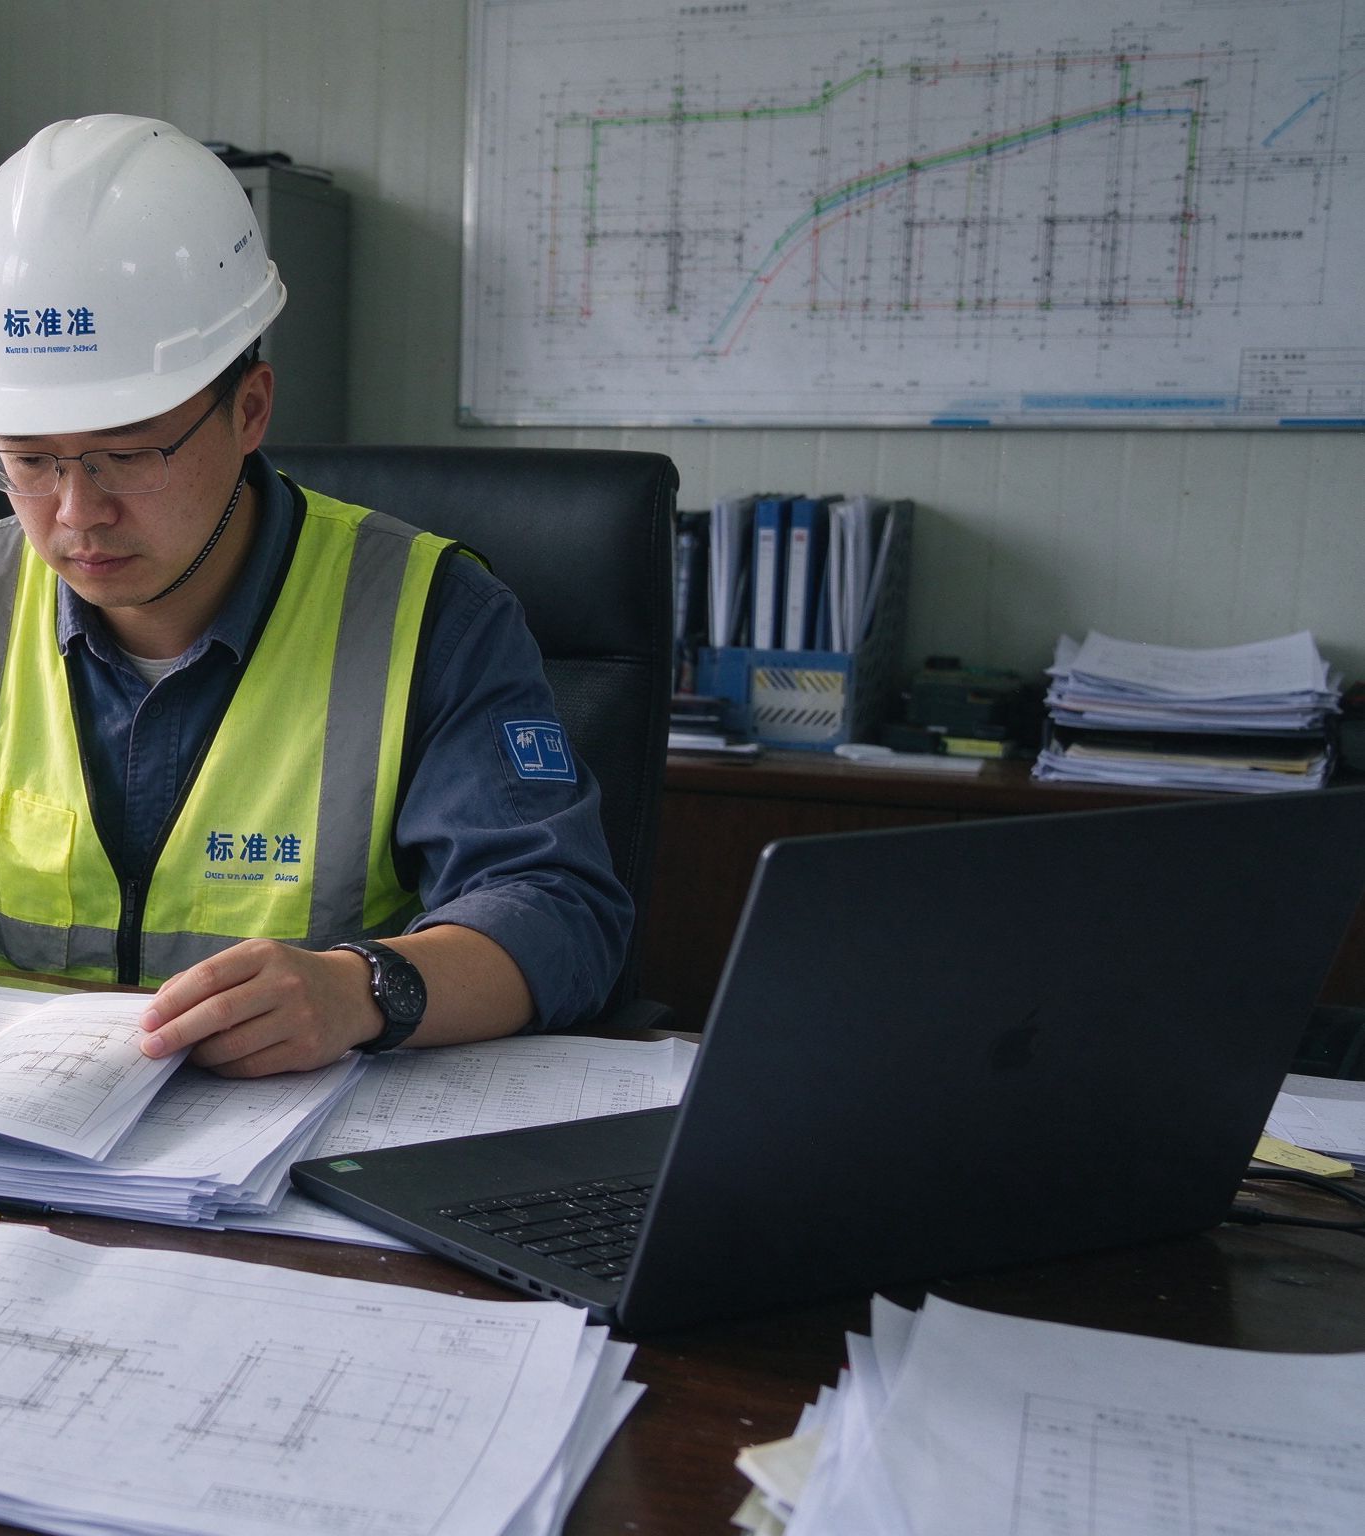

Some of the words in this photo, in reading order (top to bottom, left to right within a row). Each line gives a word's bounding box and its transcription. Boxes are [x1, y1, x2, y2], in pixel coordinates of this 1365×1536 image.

[3, 306, 96, 338] 标准准
[205, 831, 302, 864] 标准准
